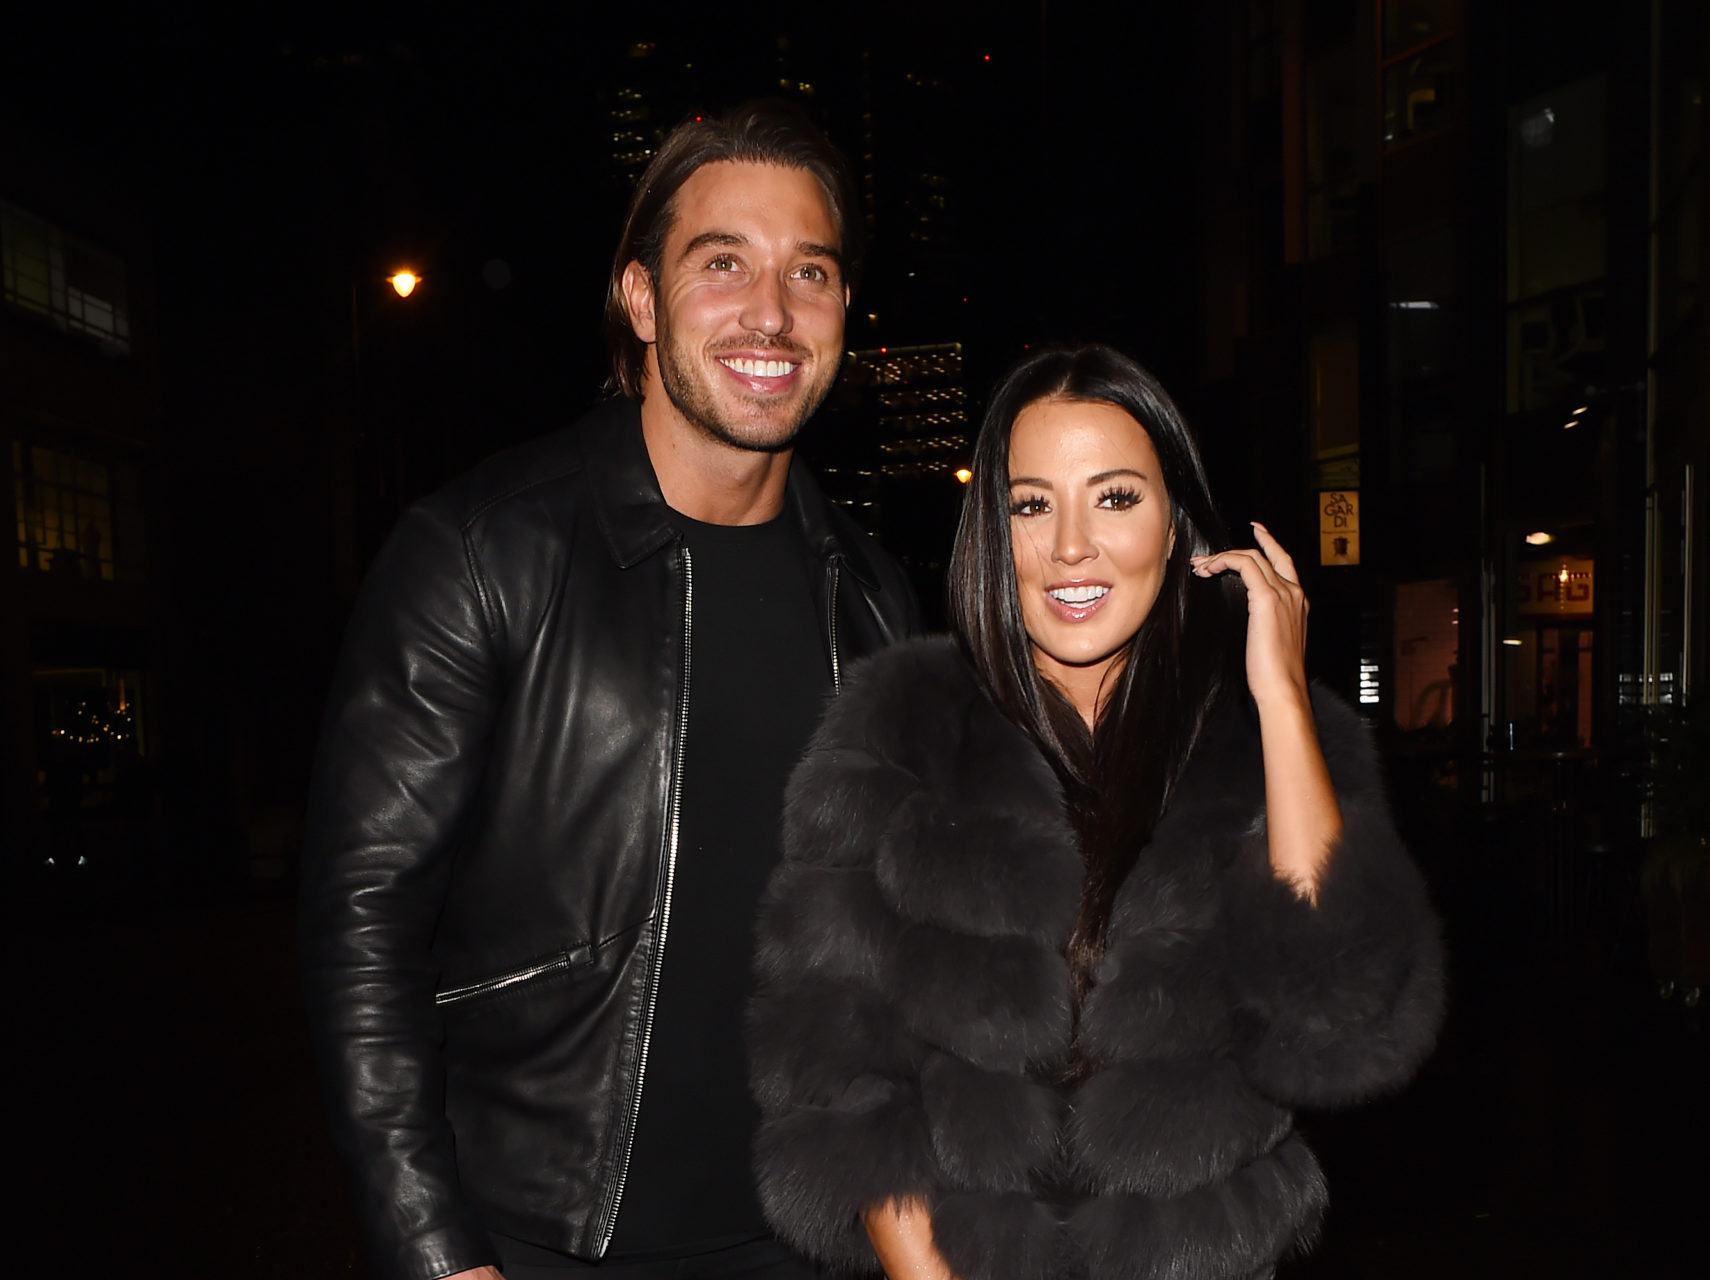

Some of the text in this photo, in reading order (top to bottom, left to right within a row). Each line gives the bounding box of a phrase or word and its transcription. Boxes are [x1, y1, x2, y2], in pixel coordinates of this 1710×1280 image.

[1330, 493, 1348, 504] SA
[1324, 503, 1354, 517] GAR
[1334, 515, 1347, 528] DI
